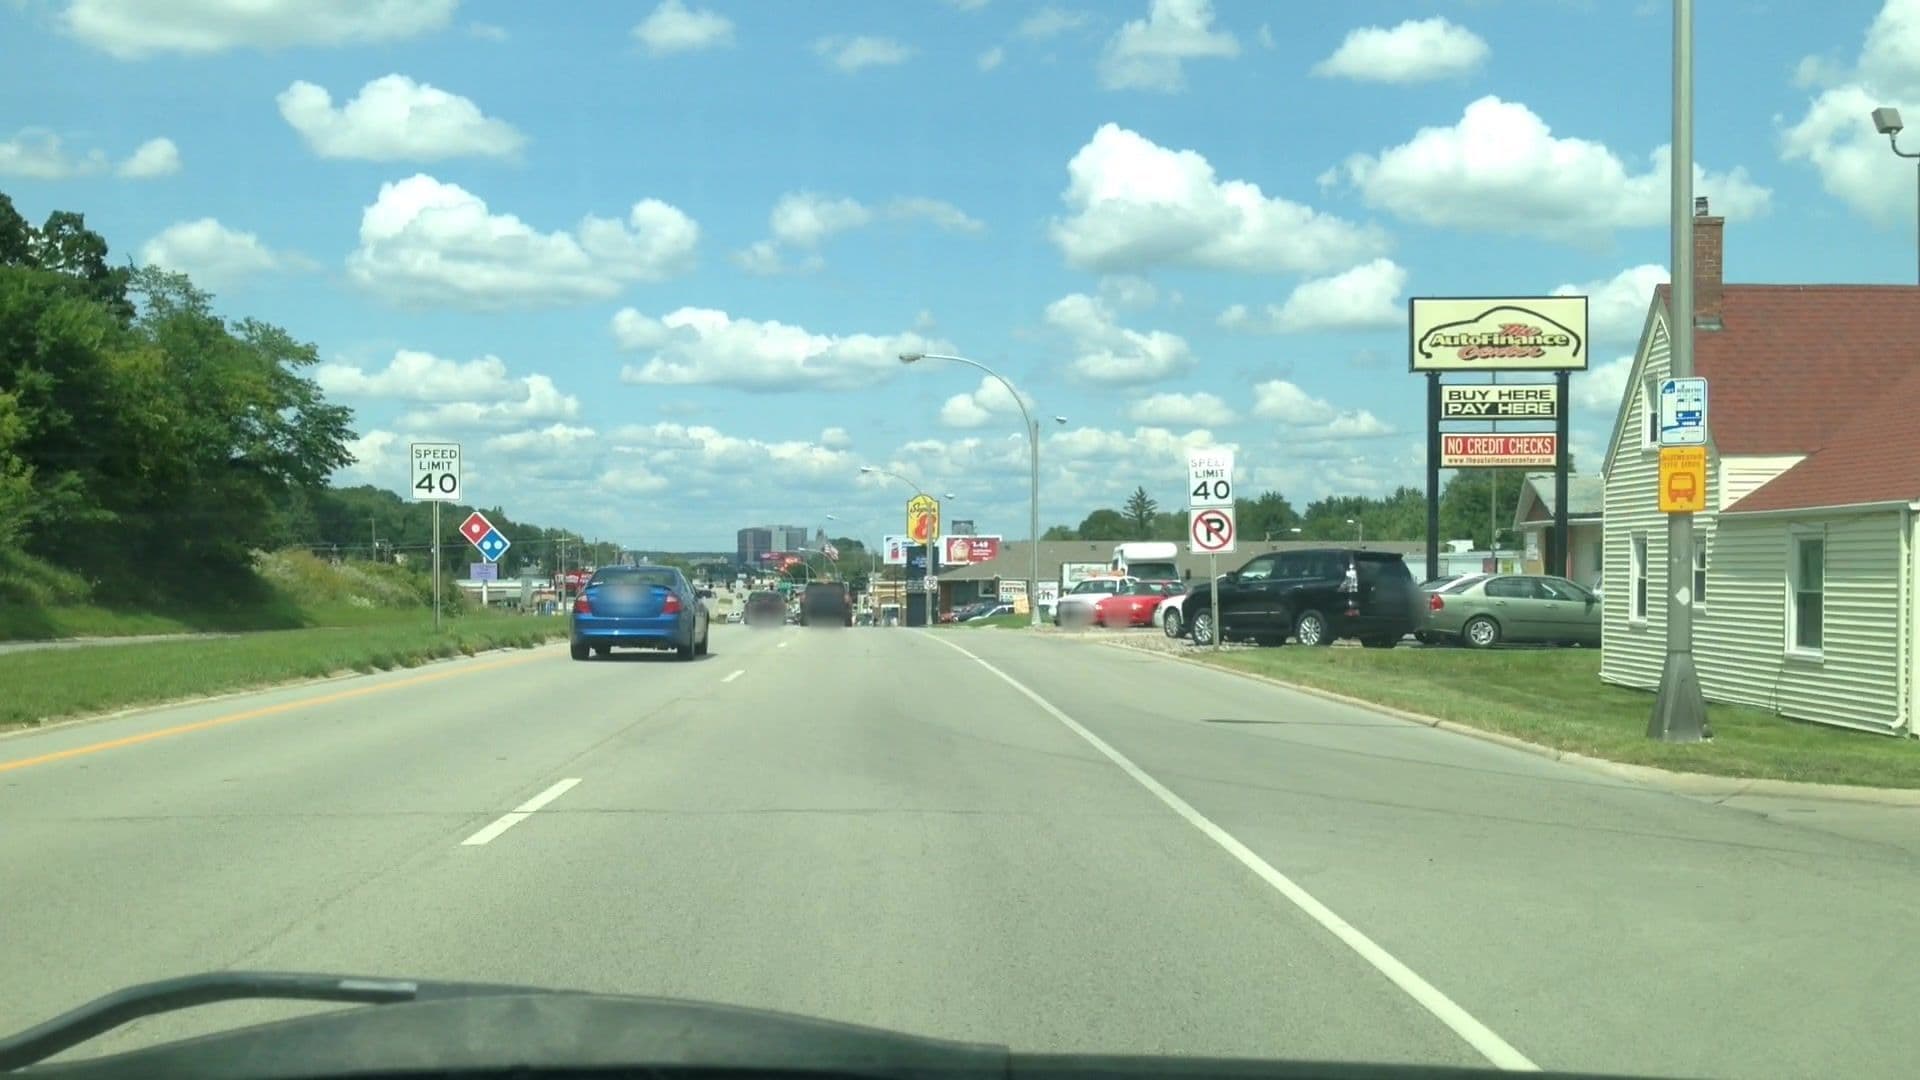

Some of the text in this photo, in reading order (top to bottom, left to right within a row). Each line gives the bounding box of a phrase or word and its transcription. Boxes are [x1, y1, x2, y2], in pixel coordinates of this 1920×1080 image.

[1499, 324, 1542, 336] The
[1431, 333, 1569, 347] AutoFinance
[1448, 389, 1551, 401] BUY HERE
[1448, 402, 1552, 415] PAY HERE
[1447, 437, 1552, 454] NO CREDIT CHECKS
[415, 449, 457, 459] SPEED
[419, 461, 452, 471] LIMIT
[1195, 469, 1225, 479] LIMIT
[415, 473, 457, 493] 40
[1192, 480, 1230, 500] 40
